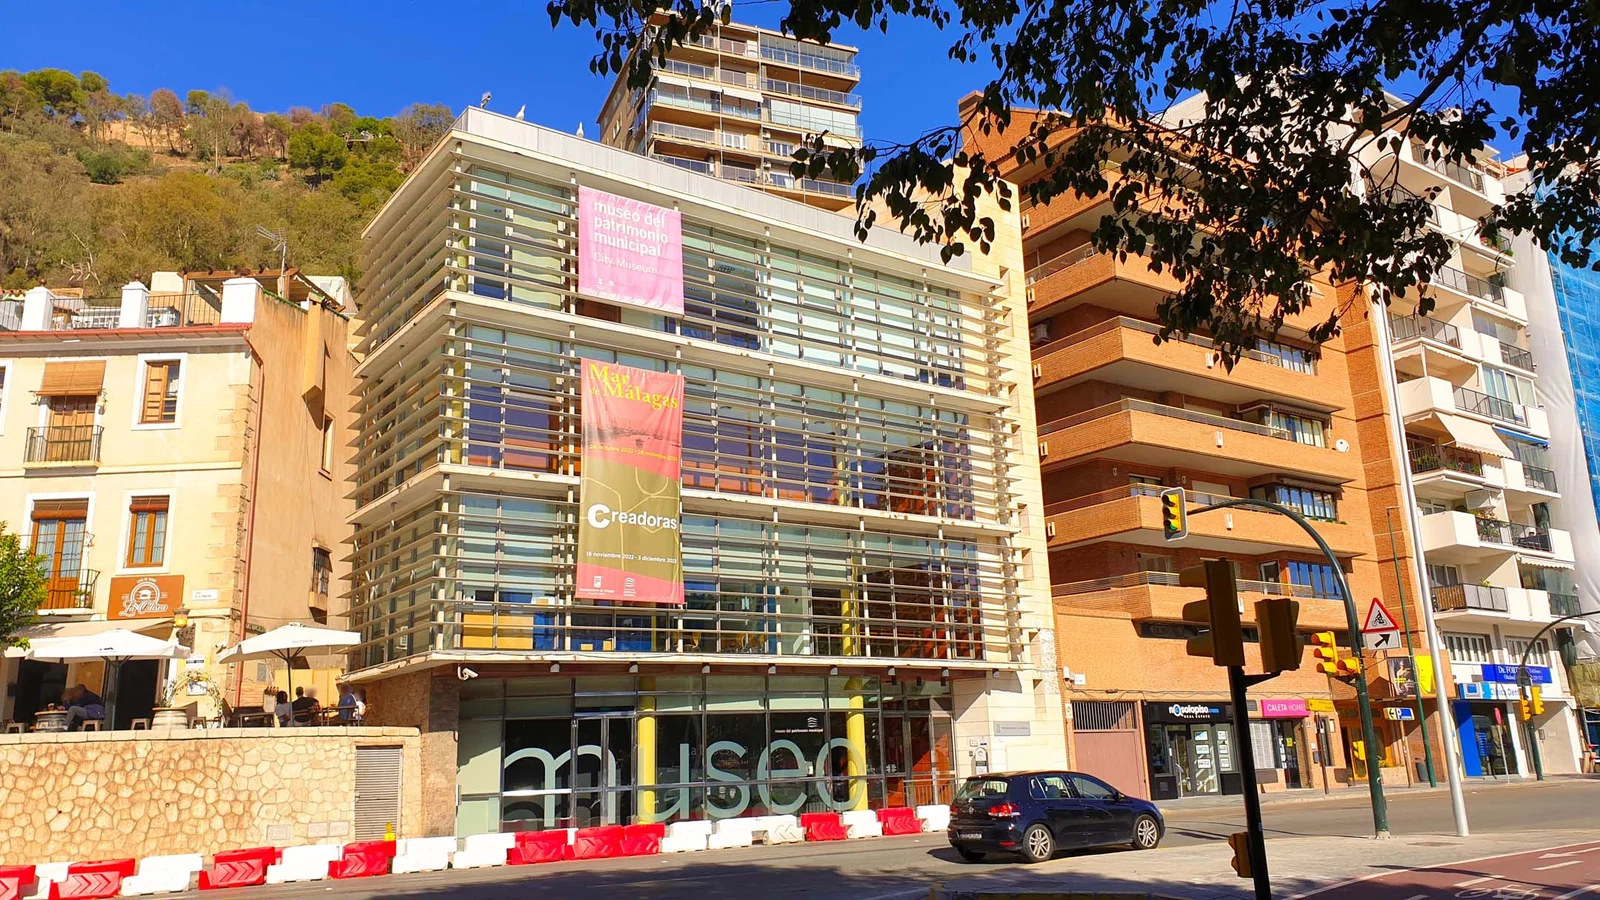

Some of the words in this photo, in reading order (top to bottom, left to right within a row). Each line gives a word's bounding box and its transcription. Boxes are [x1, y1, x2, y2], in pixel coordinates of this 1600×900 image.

[594, 201, 640, 222] museo
[644, 212, 665, 228] del
[594, 217, 668, 244] patrimonio
[594, 232, 661, 257] municipal
[593, 251, 613, 266] City
[616, 258, 657, 274] Museum
[589, 363, 629, 385] Mar
[603, 381, 679, 410] Málagas
[587, 504, 677, 530] Creadoras
[1267, 703, 1288, 712] CALETA
[504, 737, 866, 828] museo
